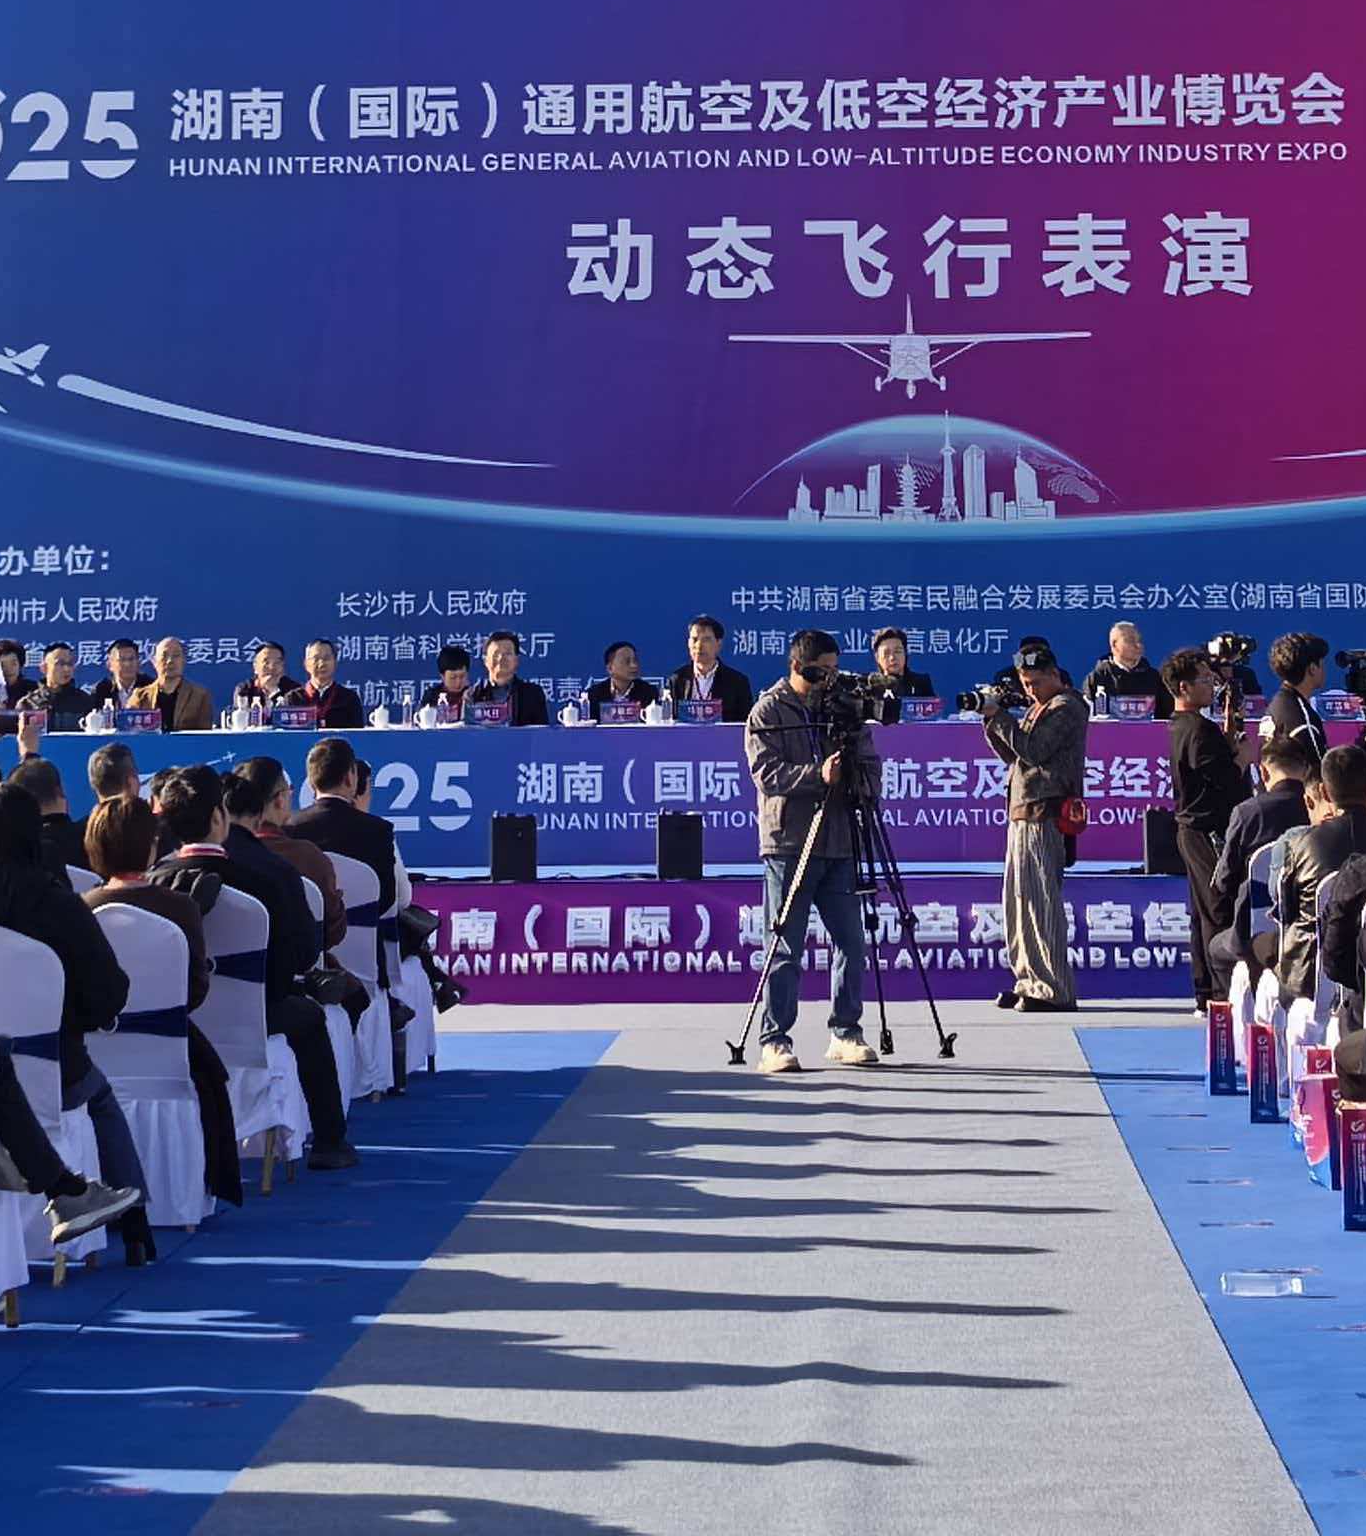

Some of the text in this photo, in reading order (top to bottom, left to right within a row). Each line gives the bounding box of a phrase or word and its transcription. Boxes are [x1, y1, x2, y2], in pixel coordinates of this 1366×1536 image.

[171, 73, 1345, 142] 湖南（国际）通用航空及低空经济产业博览会
[170, 142, 1347, 177] HUNAN INTERNATIONAL GENERAL AVIATION AND LOW-ALTITUDE ECONOMY INDUSTRY EXPO
[566, 211, 1253, 302] 动态飞行表演
[336, 589, 527, 618] 长沙市人民政府
[915, 808, 1008, 826] AVIATIO
[500, 950, 741, 975] INTERNATIONAL
